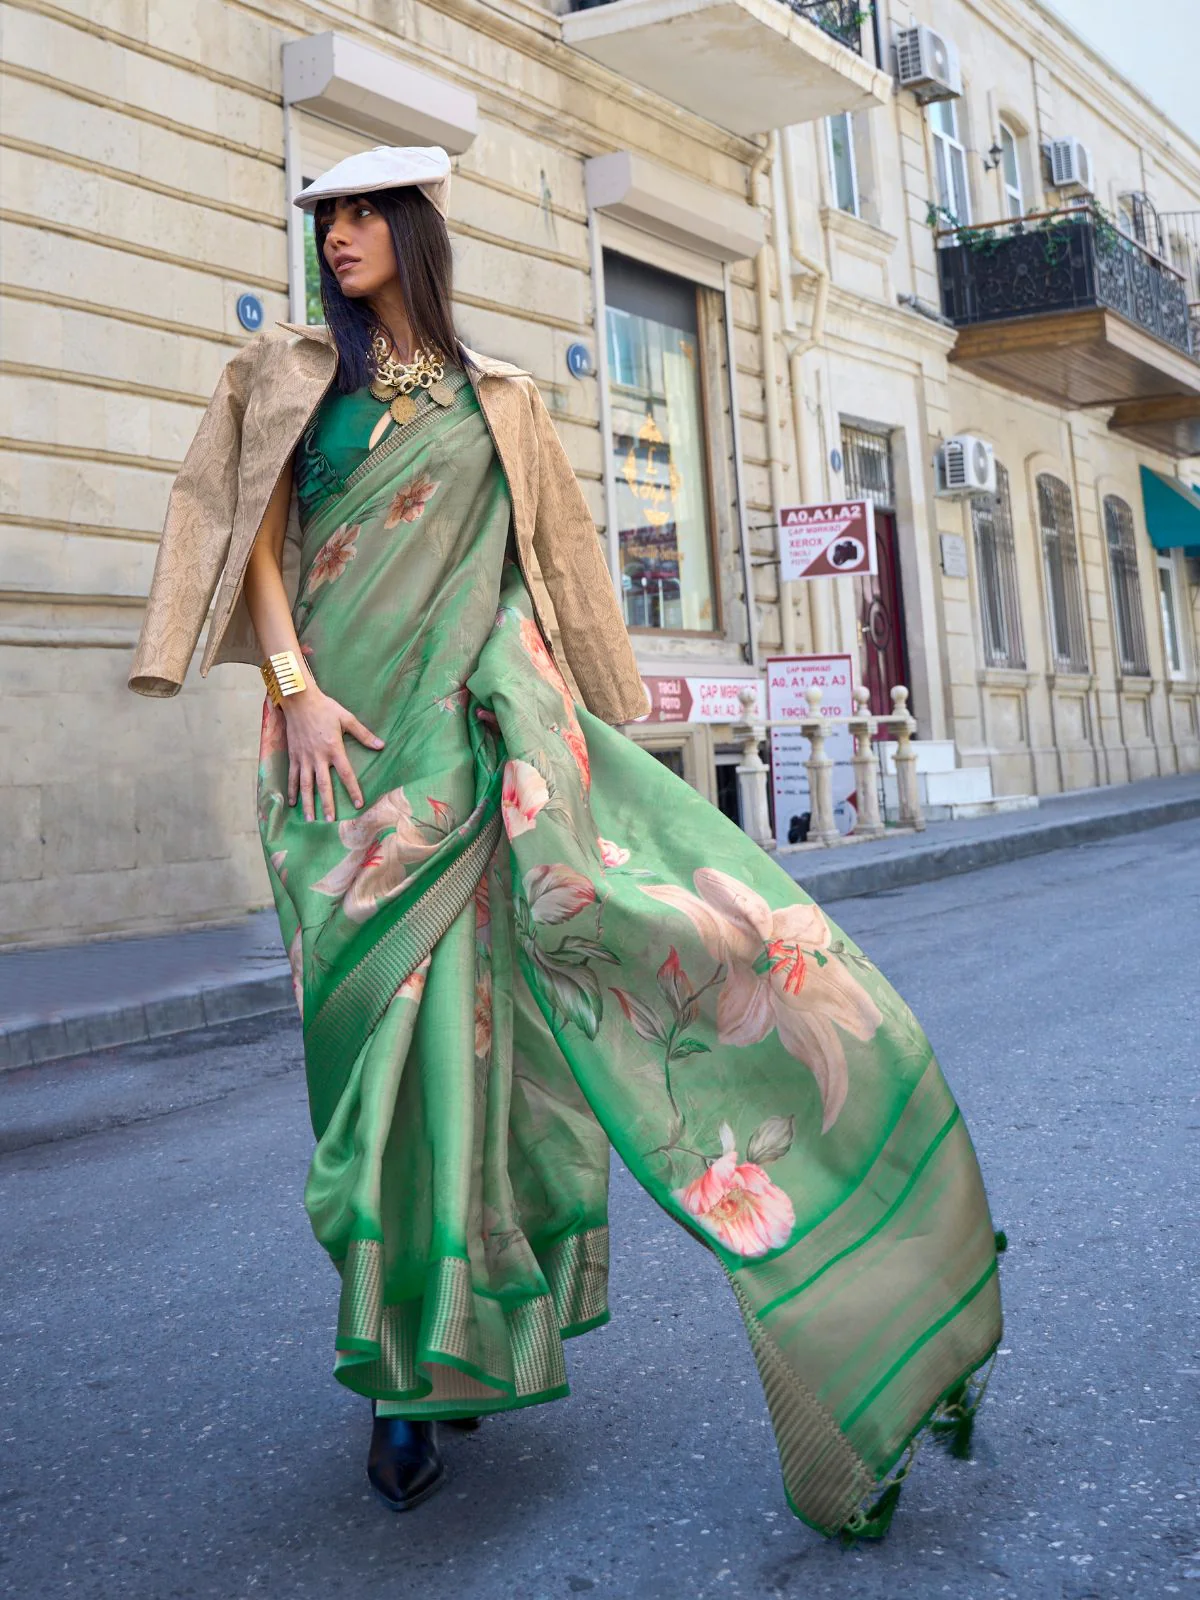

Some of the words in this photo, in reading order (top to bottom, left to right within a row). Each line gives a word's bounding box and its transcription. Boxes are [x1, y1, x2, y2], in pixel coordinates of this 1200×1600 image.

[789, 538, 823, 548] XEROX
[831, 675, 847, 685] A3
[700, 684, 718, 700] ÇAP
[660, 697, 681, 710] FOTO
